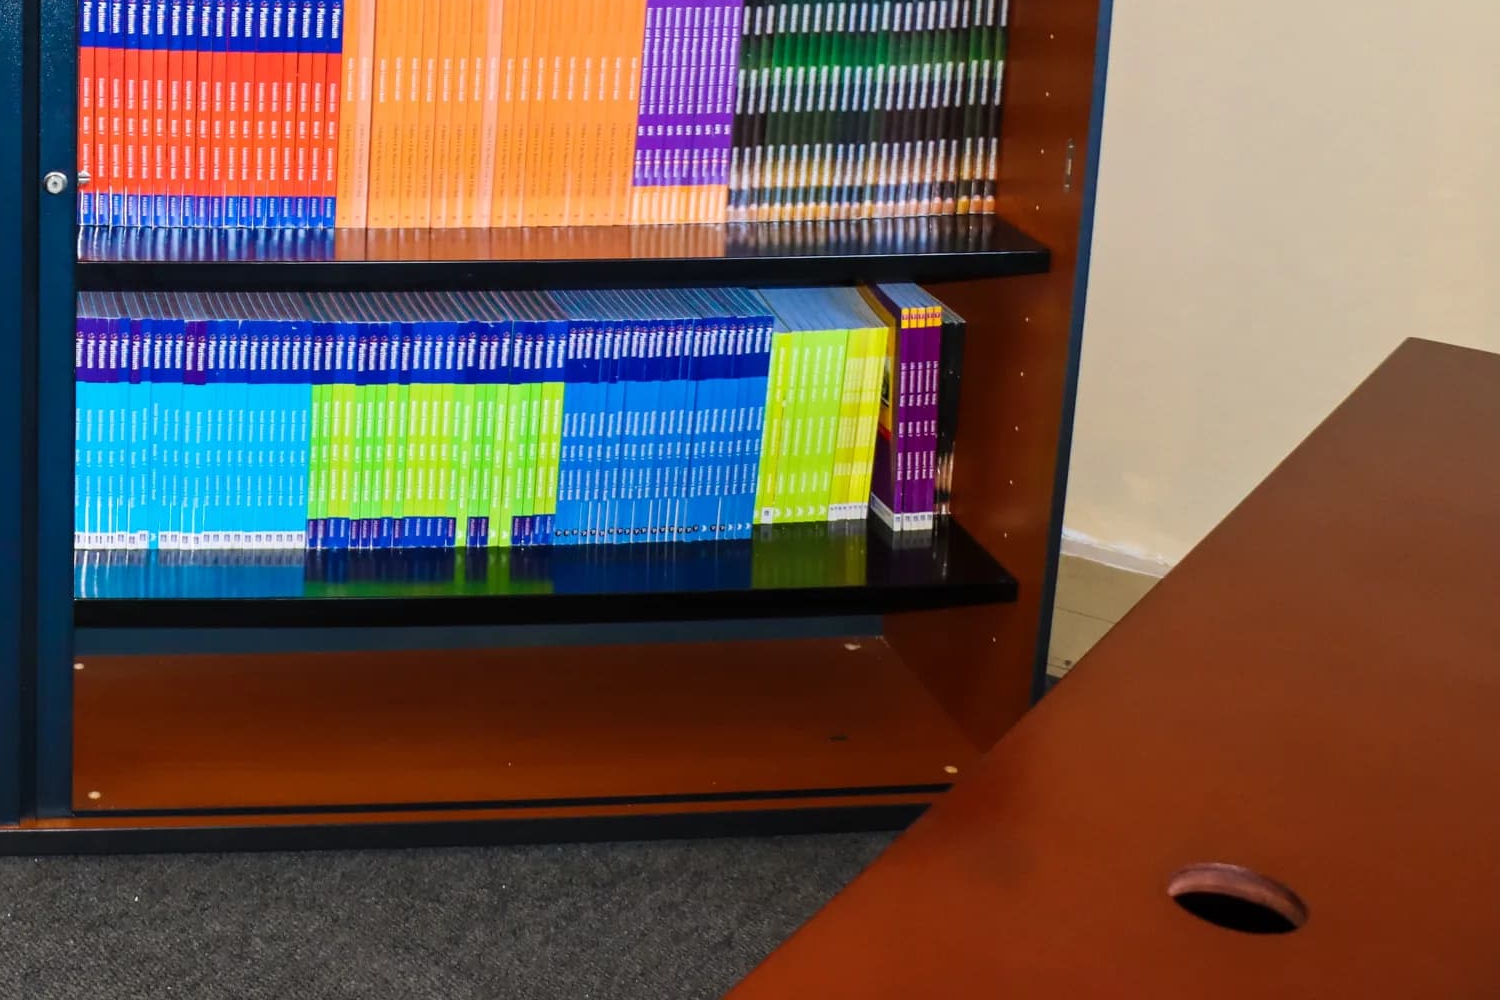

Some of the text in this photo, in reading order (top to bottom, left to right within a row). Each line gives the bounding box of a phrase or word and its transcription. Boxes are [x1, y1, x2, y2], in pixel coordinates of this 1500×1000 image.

[84, 2, 92, 32] Platinum
[98, 3, 106, 32] Platinum
[113, 4, 121, 33] Platinum
[128, 5, 136, 34] Platinum
[143, 5, 151, 35] Platinum
[157, 5, 166, 35] Platinum
[172, 6, 180, 36] Platinum
[187, 6, 195, 36] Platinum
[202, 7, 211, 36] Platinum
[216, 8, 225, 37] Platinum
[232, 7, 240, 37] Platinum
[245, 8, 254, 37] Platinum
[260, 8, 268, 38] Platinum
[274, 8, 282, 37] Platinum
[288, 8, 296, 38] Platinum
[302, 8, 311, 38] Platinum
[316, 8, 325, 38] Platinum
[332, 9, 340, 38] Platinum
